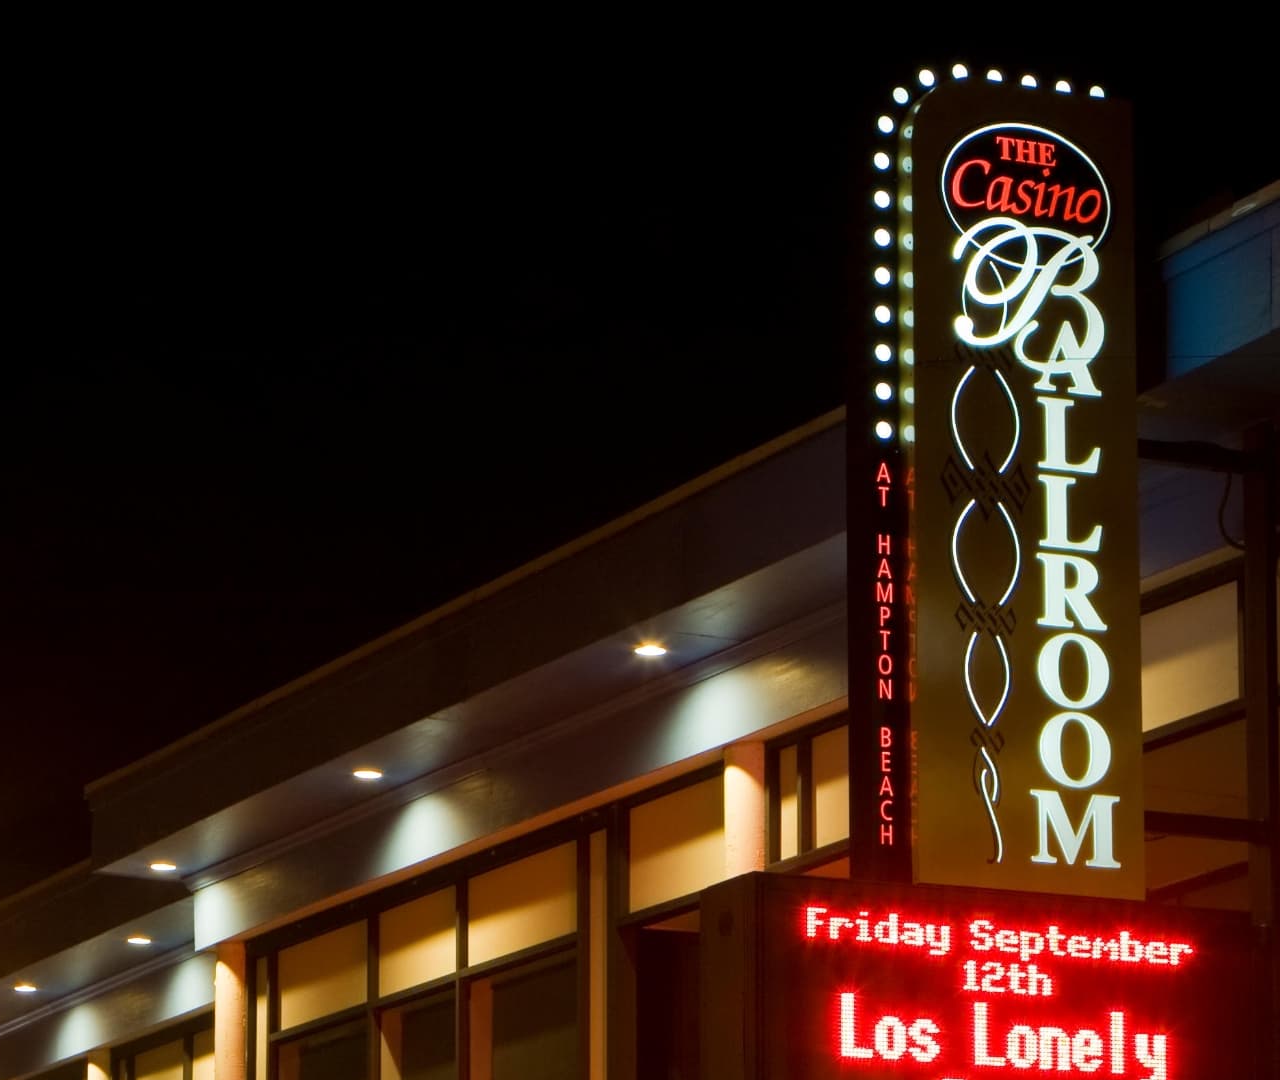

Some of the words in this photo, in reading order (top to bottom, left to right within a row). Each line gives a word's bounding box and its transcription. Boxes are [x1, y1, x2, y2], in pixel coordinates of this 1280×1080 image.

[996, 136, 1057, 167] THE
[952, 159, 1102, 223] Casino
[876, 462, 892, 507] AT
[953, 216, 1122, 870] BALLROOM
[876, 534, 893, 700] HAMPTON
[878, 727, 894, 846] BEACH
[806, 906, 952, 956] Friday
[969, 919, 1194, 966] September
[962, 960, 1053, 997] 12th
[840, 992, 942, 1063] Los
